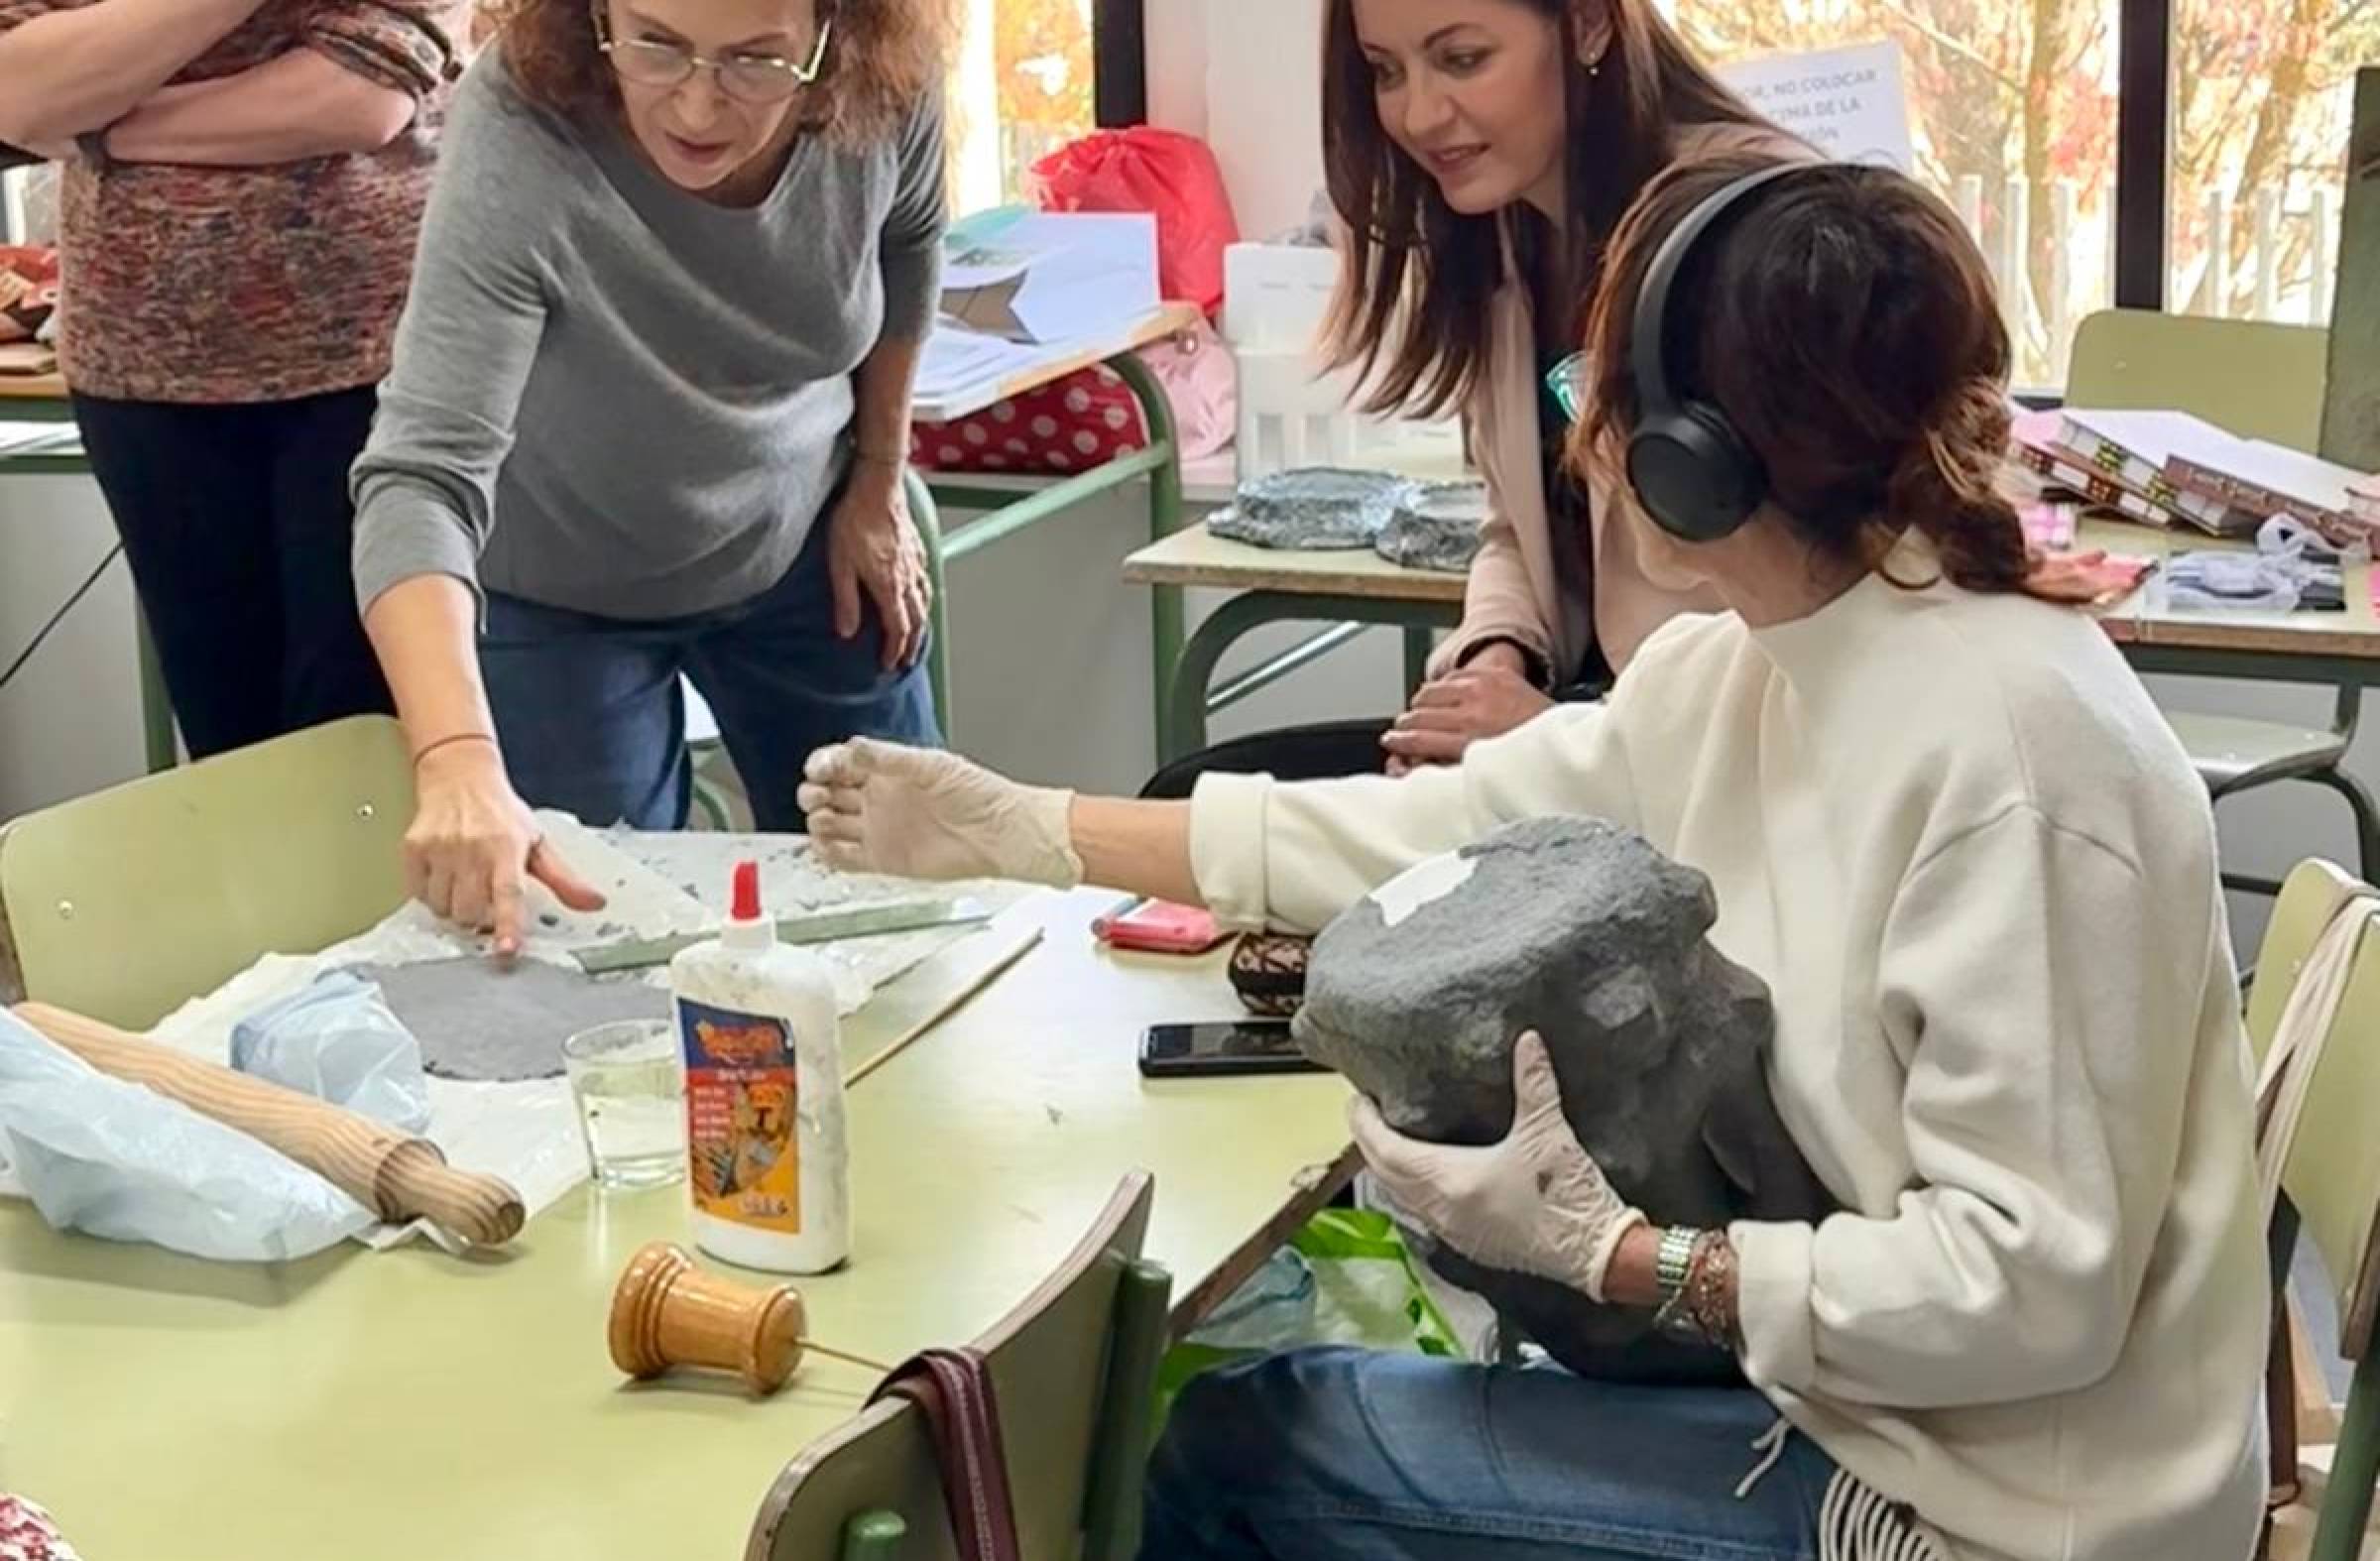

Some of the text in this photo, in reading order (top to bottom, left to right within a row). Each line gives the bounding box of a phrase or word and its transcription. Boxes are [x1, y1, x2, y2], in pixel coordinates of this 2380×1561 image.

[1773, 80, 1796, 95] NO
[1800, 68, 1876, 92] COLOCAR
[1815, 99, 1835, 116] DE
[1840, 96, 1861, 113] LA
